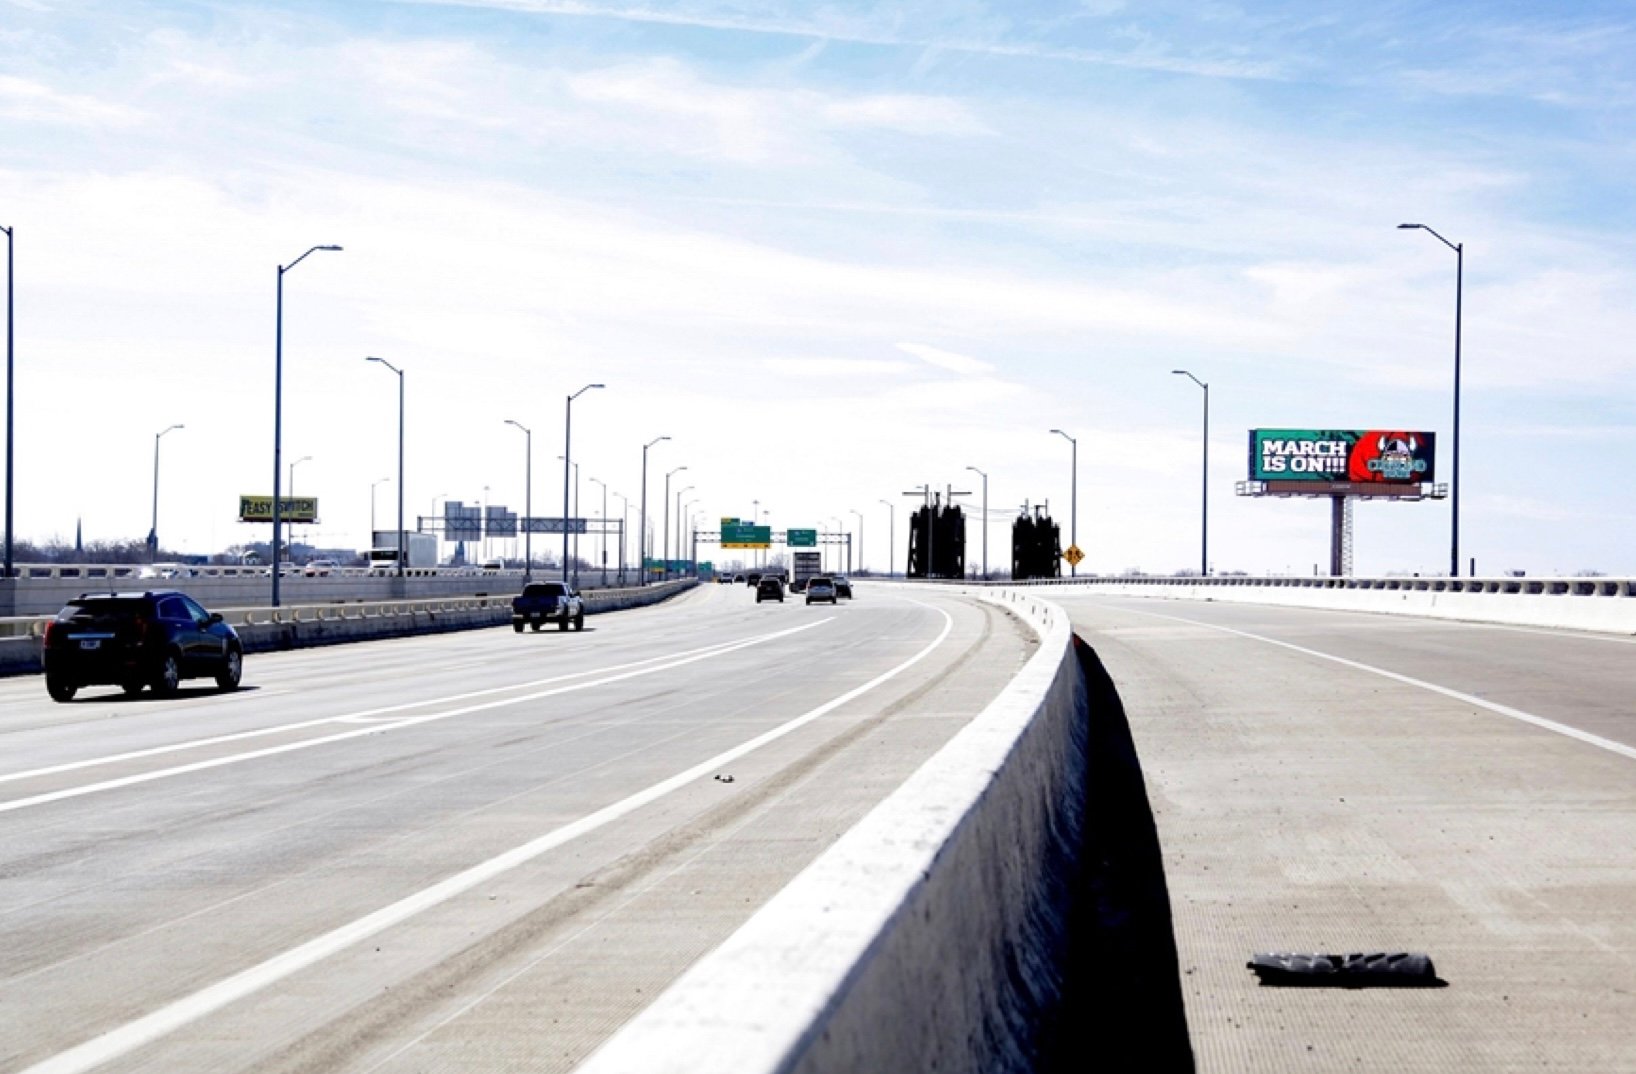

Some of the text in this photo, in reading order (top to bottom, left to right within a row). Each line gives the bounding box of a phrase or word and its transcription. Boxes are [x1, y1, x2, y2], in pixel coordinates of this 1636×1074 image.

[1262, 440, 1347, 456] MARCH
[1262, 457, 1346, 472] IS ON!!!
